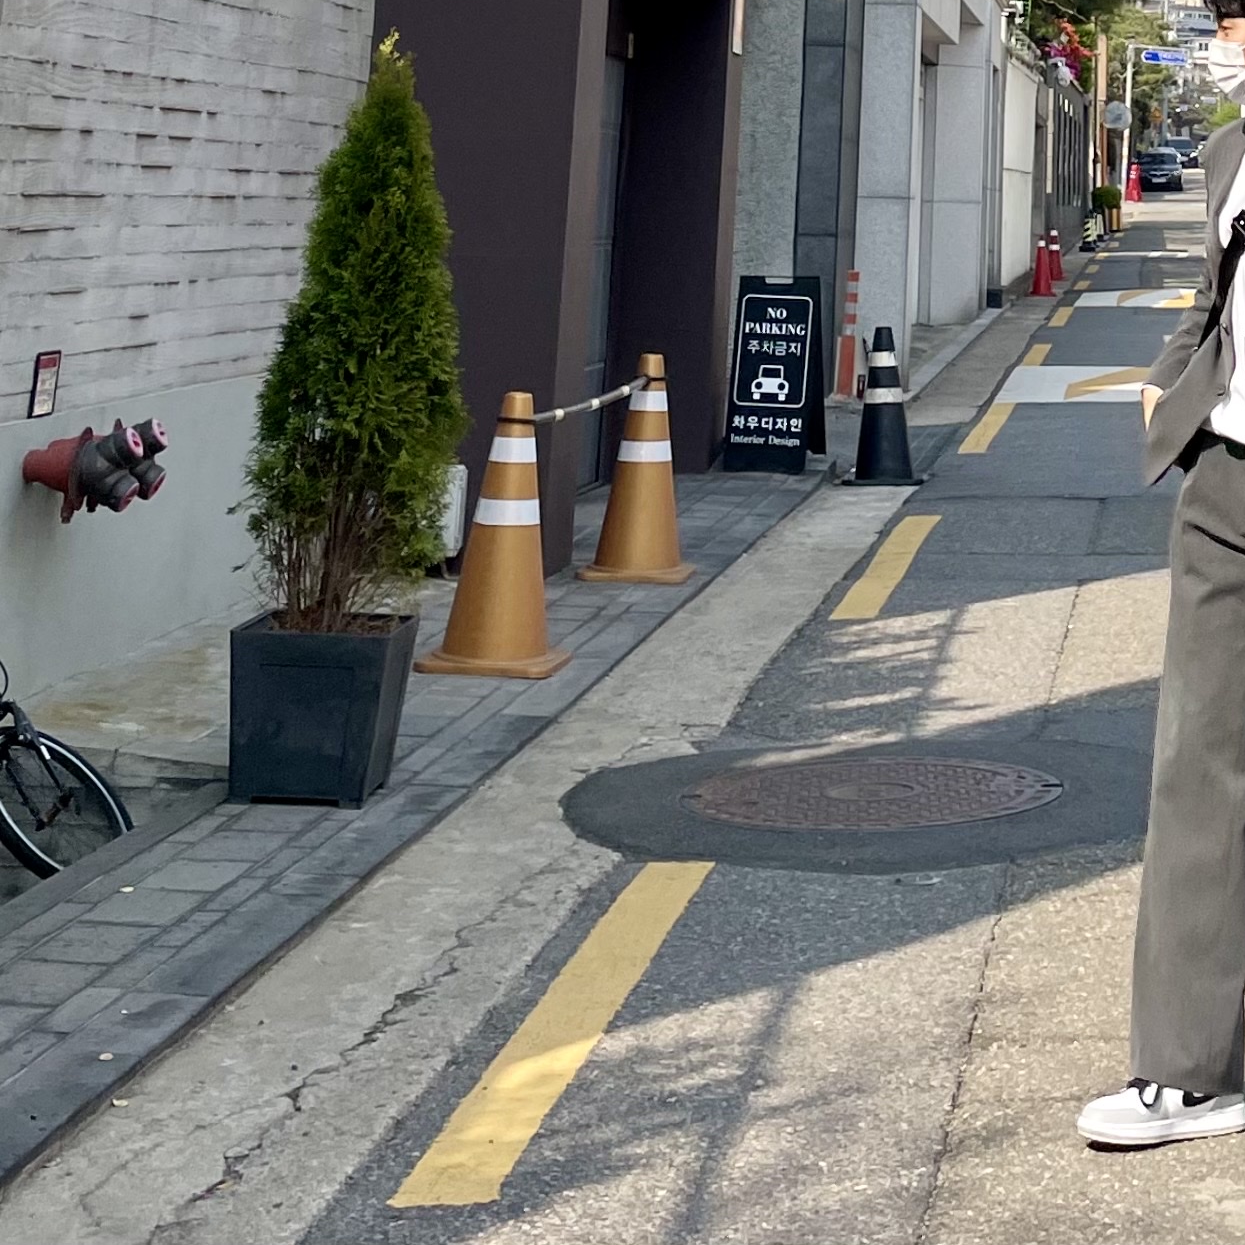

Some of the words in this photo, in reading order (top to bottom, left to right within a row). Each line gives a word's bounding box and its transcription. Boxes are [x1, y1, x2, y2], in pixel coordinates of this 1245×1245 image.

[766, 307, 787, 320] NO
[745, 321, 806, 336] PARKING
[747, 339, 802, 357] 주차금지
[731, 415, 803, 432] 차우디자인
[730, 433, 766, 445] Interior
[768, 435, 800, 448] Design
